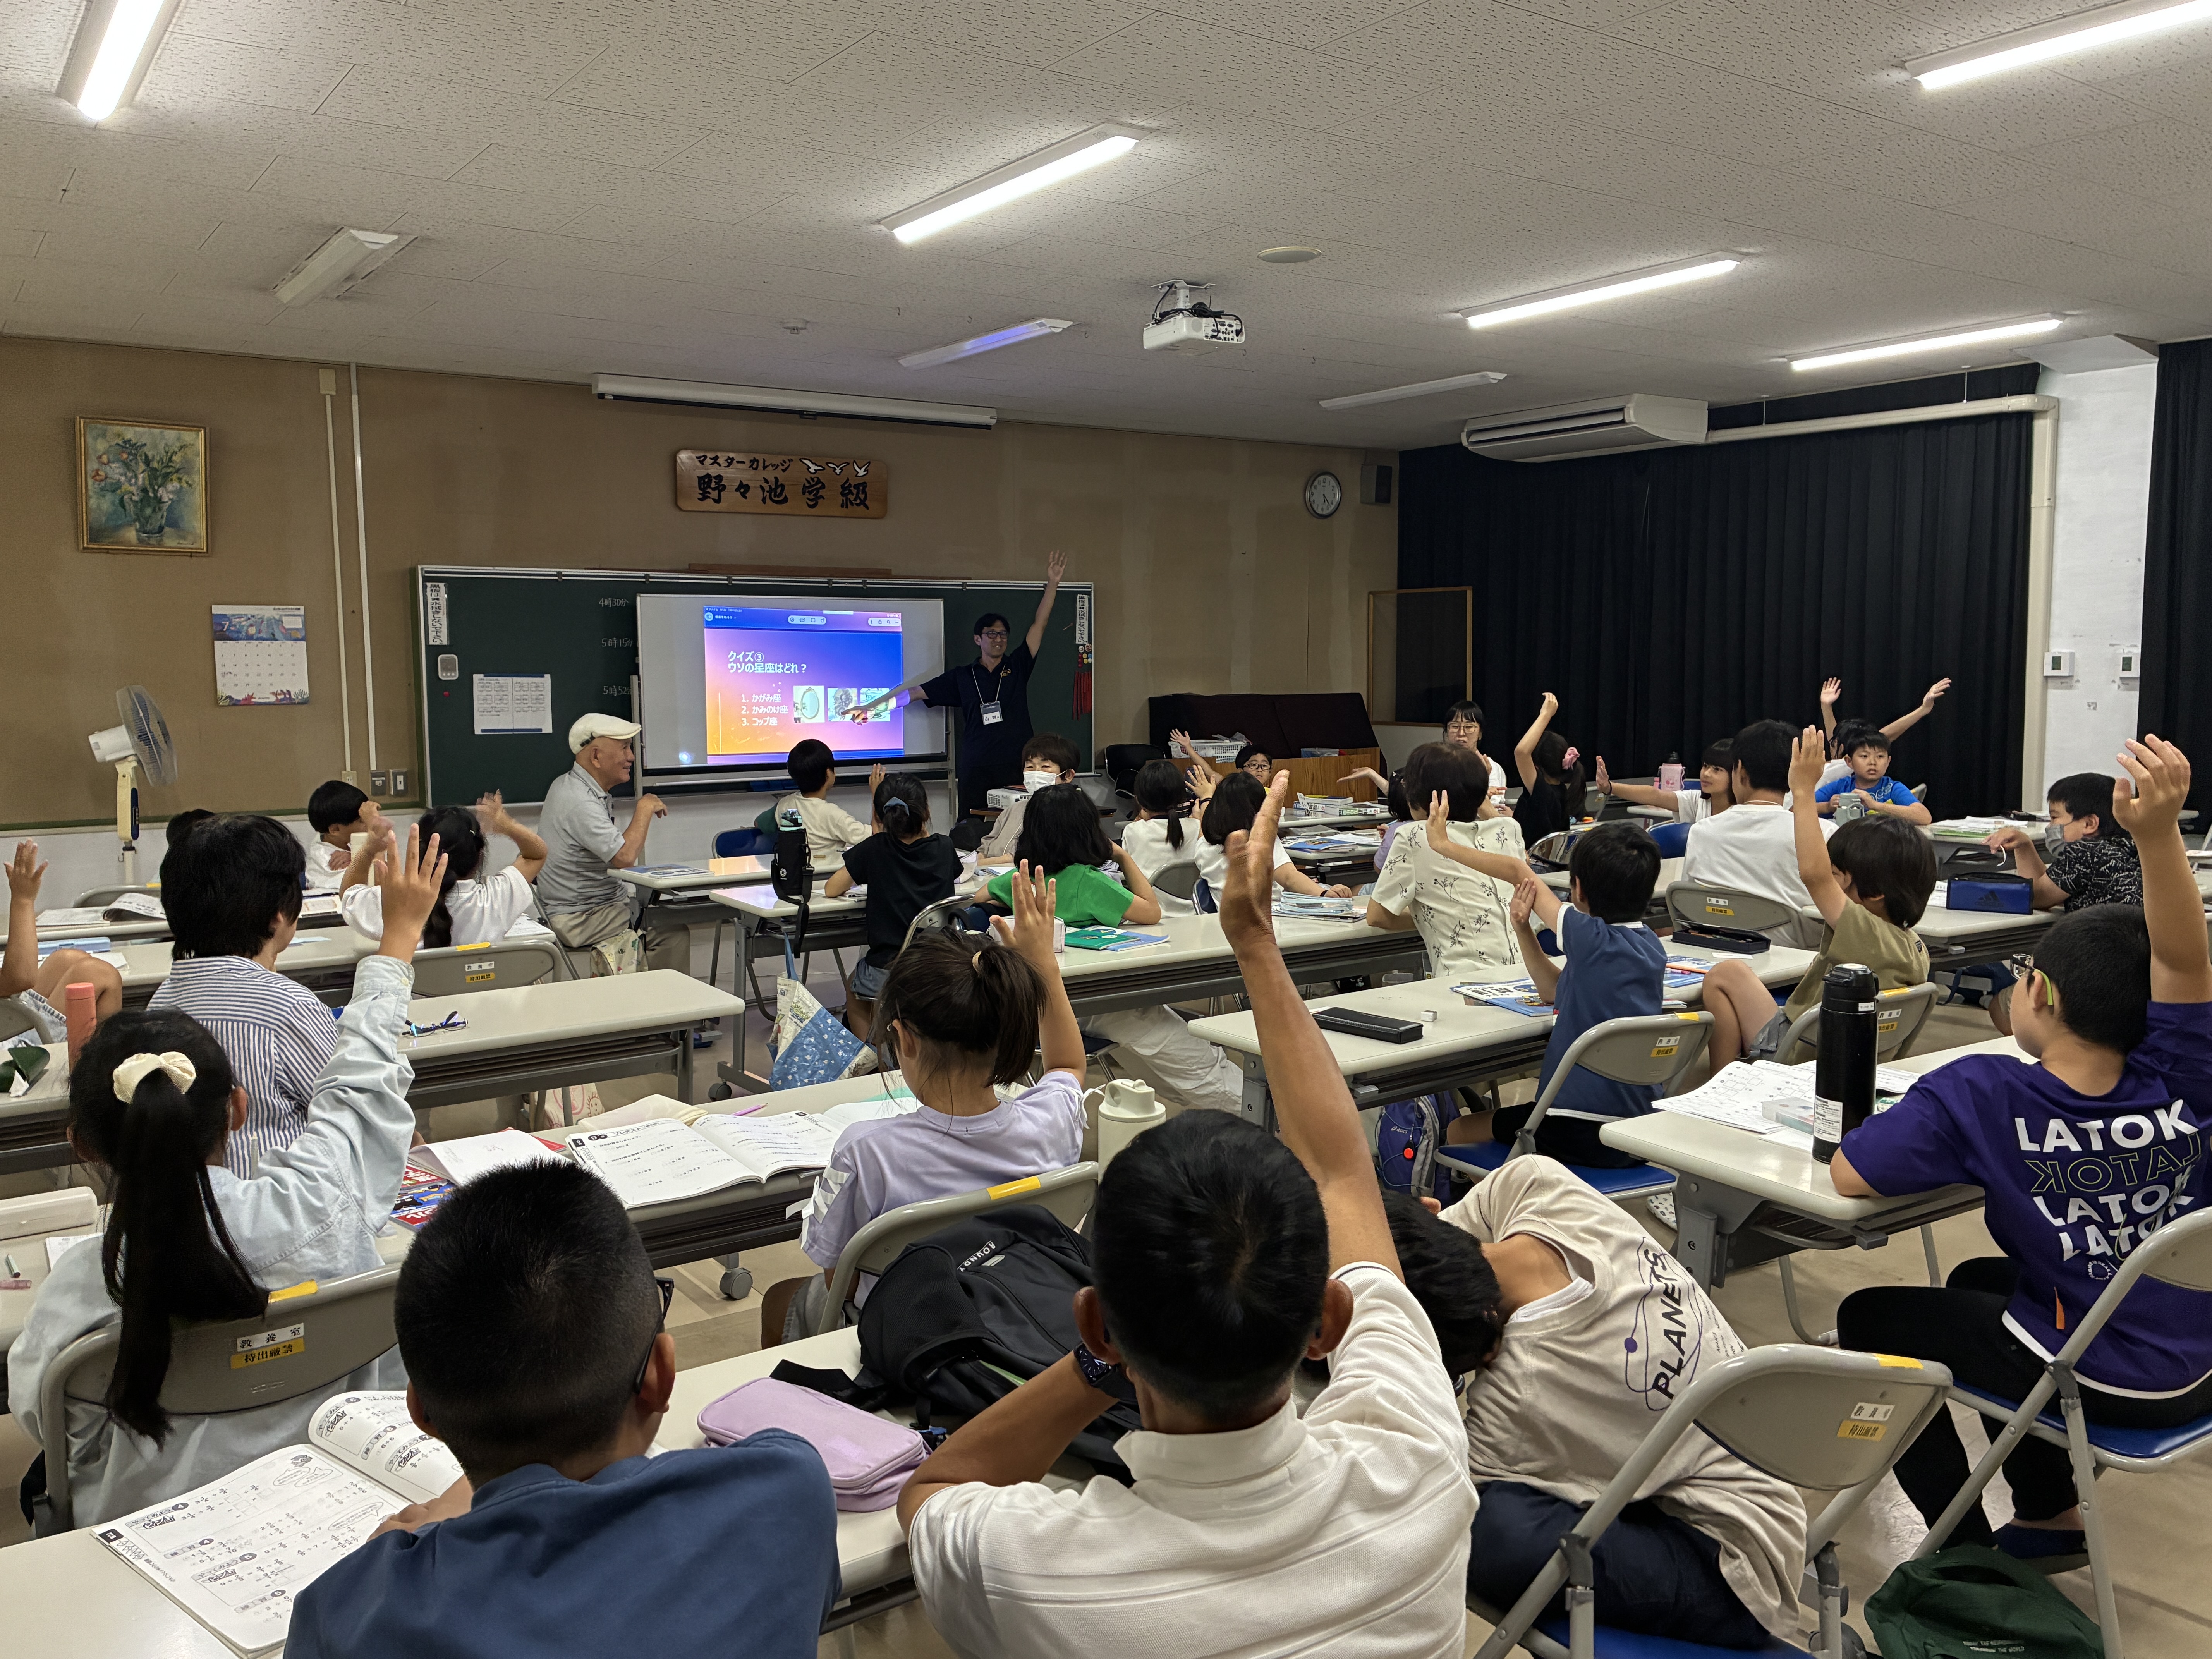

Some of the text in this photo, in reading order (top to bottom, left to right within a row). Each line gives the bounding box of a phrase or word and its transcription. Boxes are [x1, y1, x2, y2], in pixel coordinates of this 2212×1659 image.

[696, 455, 793, 472] マスターカレッジ
[697, 472, 869, 510] 野々池学級
[599, 598, 629, 607] 4時30分
[222, 622, 229, 631] 7
[602, 637, 633, 648] 5時15分
[728, 651, 764, 662] クイズ③
[728, 662, 807, 673] ウソの星座はどれ？
[741, 693, 781, 702] 1. かがみ座
[741, 705, 788, 714] 2. かみのけ座
[741, 716, 778, 726] 3. コップ座
[2015, 1099, 2199, 1152] LATOK
[2033, 1165, 2195, 1226] LATOK
[959, 1242, 996, 1272] ROUNDY
[1644, 1249, 1686, 1400] PLANETS
